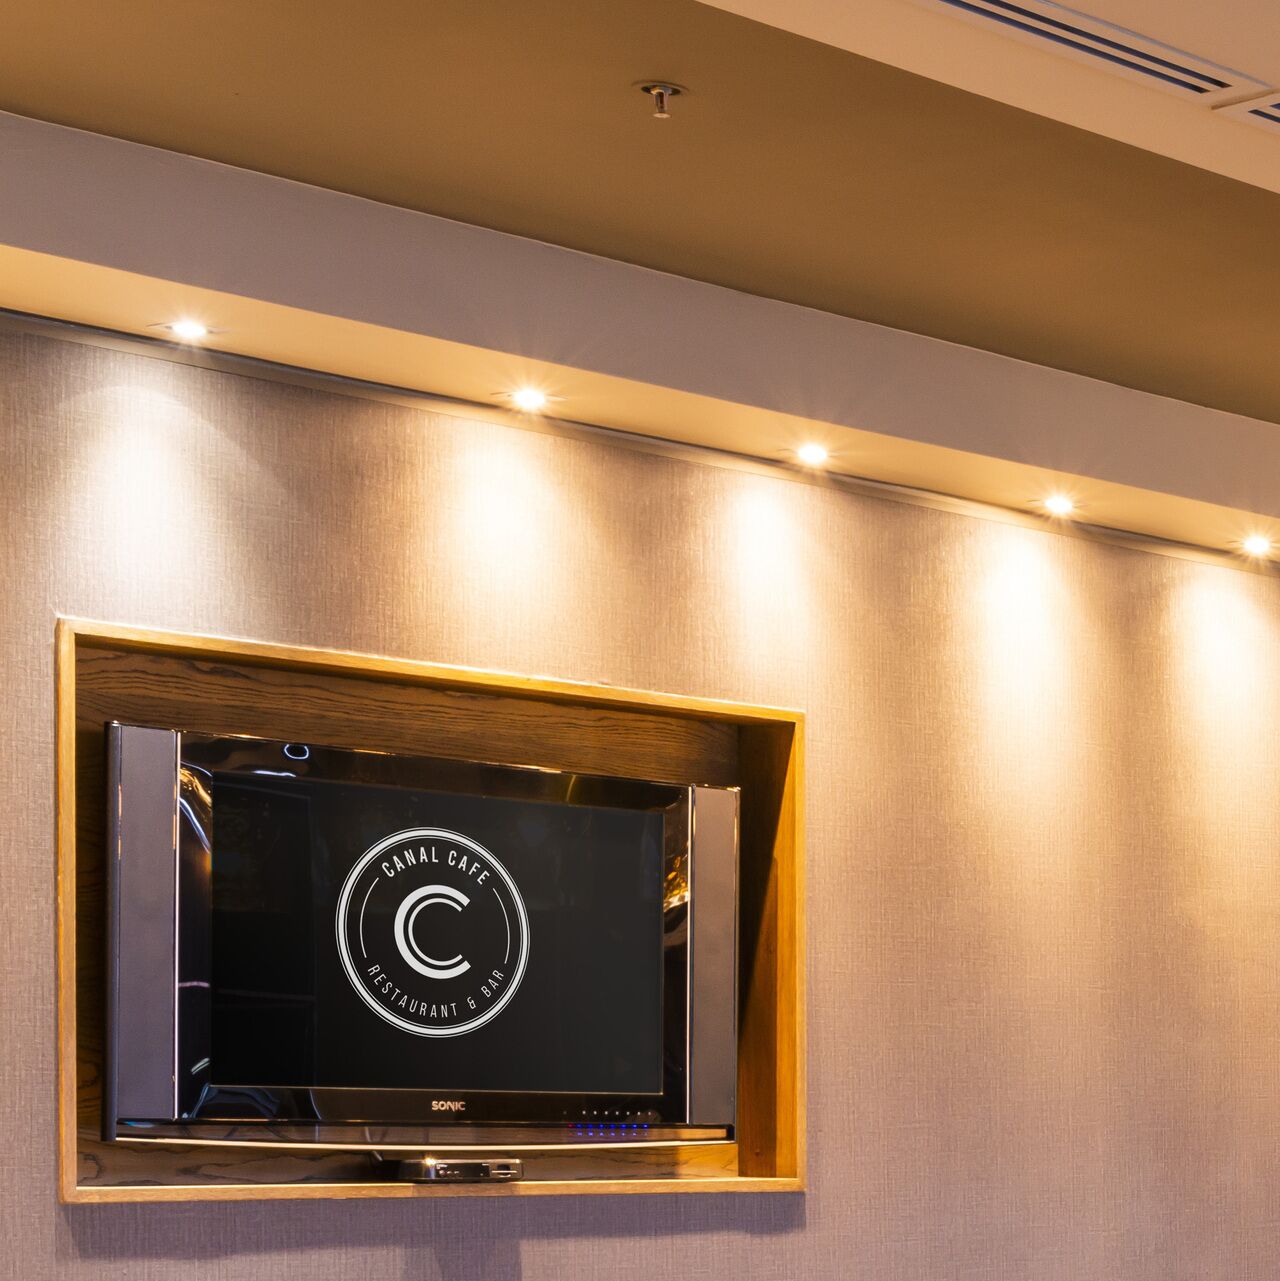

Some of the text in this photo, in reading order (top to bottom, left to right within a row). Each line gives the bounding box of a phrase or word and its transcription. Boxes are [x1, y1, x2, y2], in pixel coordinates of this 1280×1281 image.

[381, 846, 490, 885] CANAL CAFE
[367, 964, 457, 1018] RESTAURANT
[480, 968, 504, 998] BAR
[431, 1101, 466, 1112] SONIC
